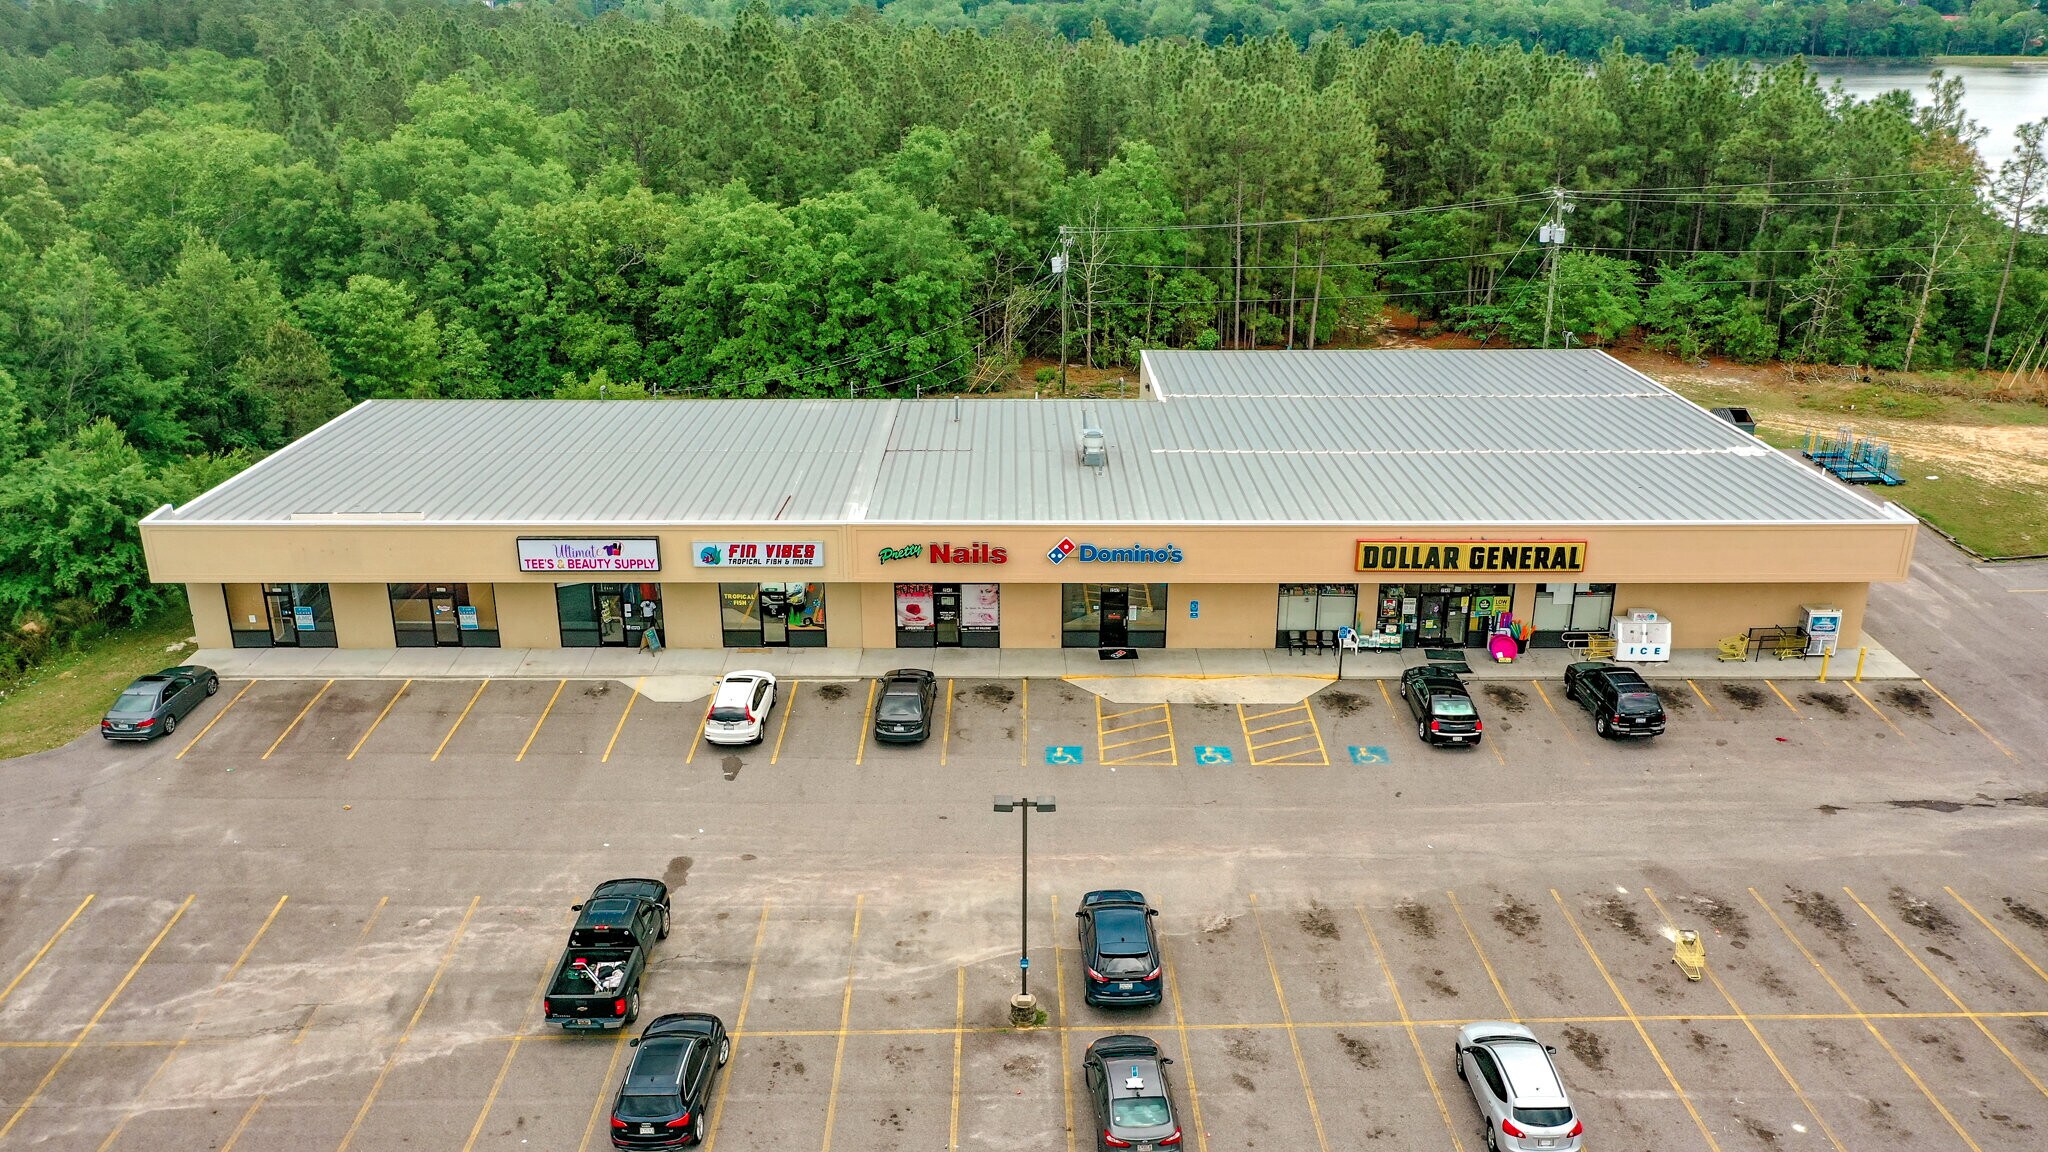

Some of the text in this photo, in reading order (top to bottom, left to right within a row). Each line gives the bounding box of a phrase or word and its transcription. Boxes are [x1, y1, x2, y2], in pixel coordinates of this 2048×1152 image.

[728, 544, 816, 558] FIN VIBES
[878, 542, 1008, 565] Pretty Nails
[1078, 543, 1184, 563] Domino's
[1363, 546, 1581, 570] DOLLAR GENERAL
[524, 559, 655, 569] TEE'S & BEAUTY SUPPLY
[1630, 647, 1661, 655] ICE
